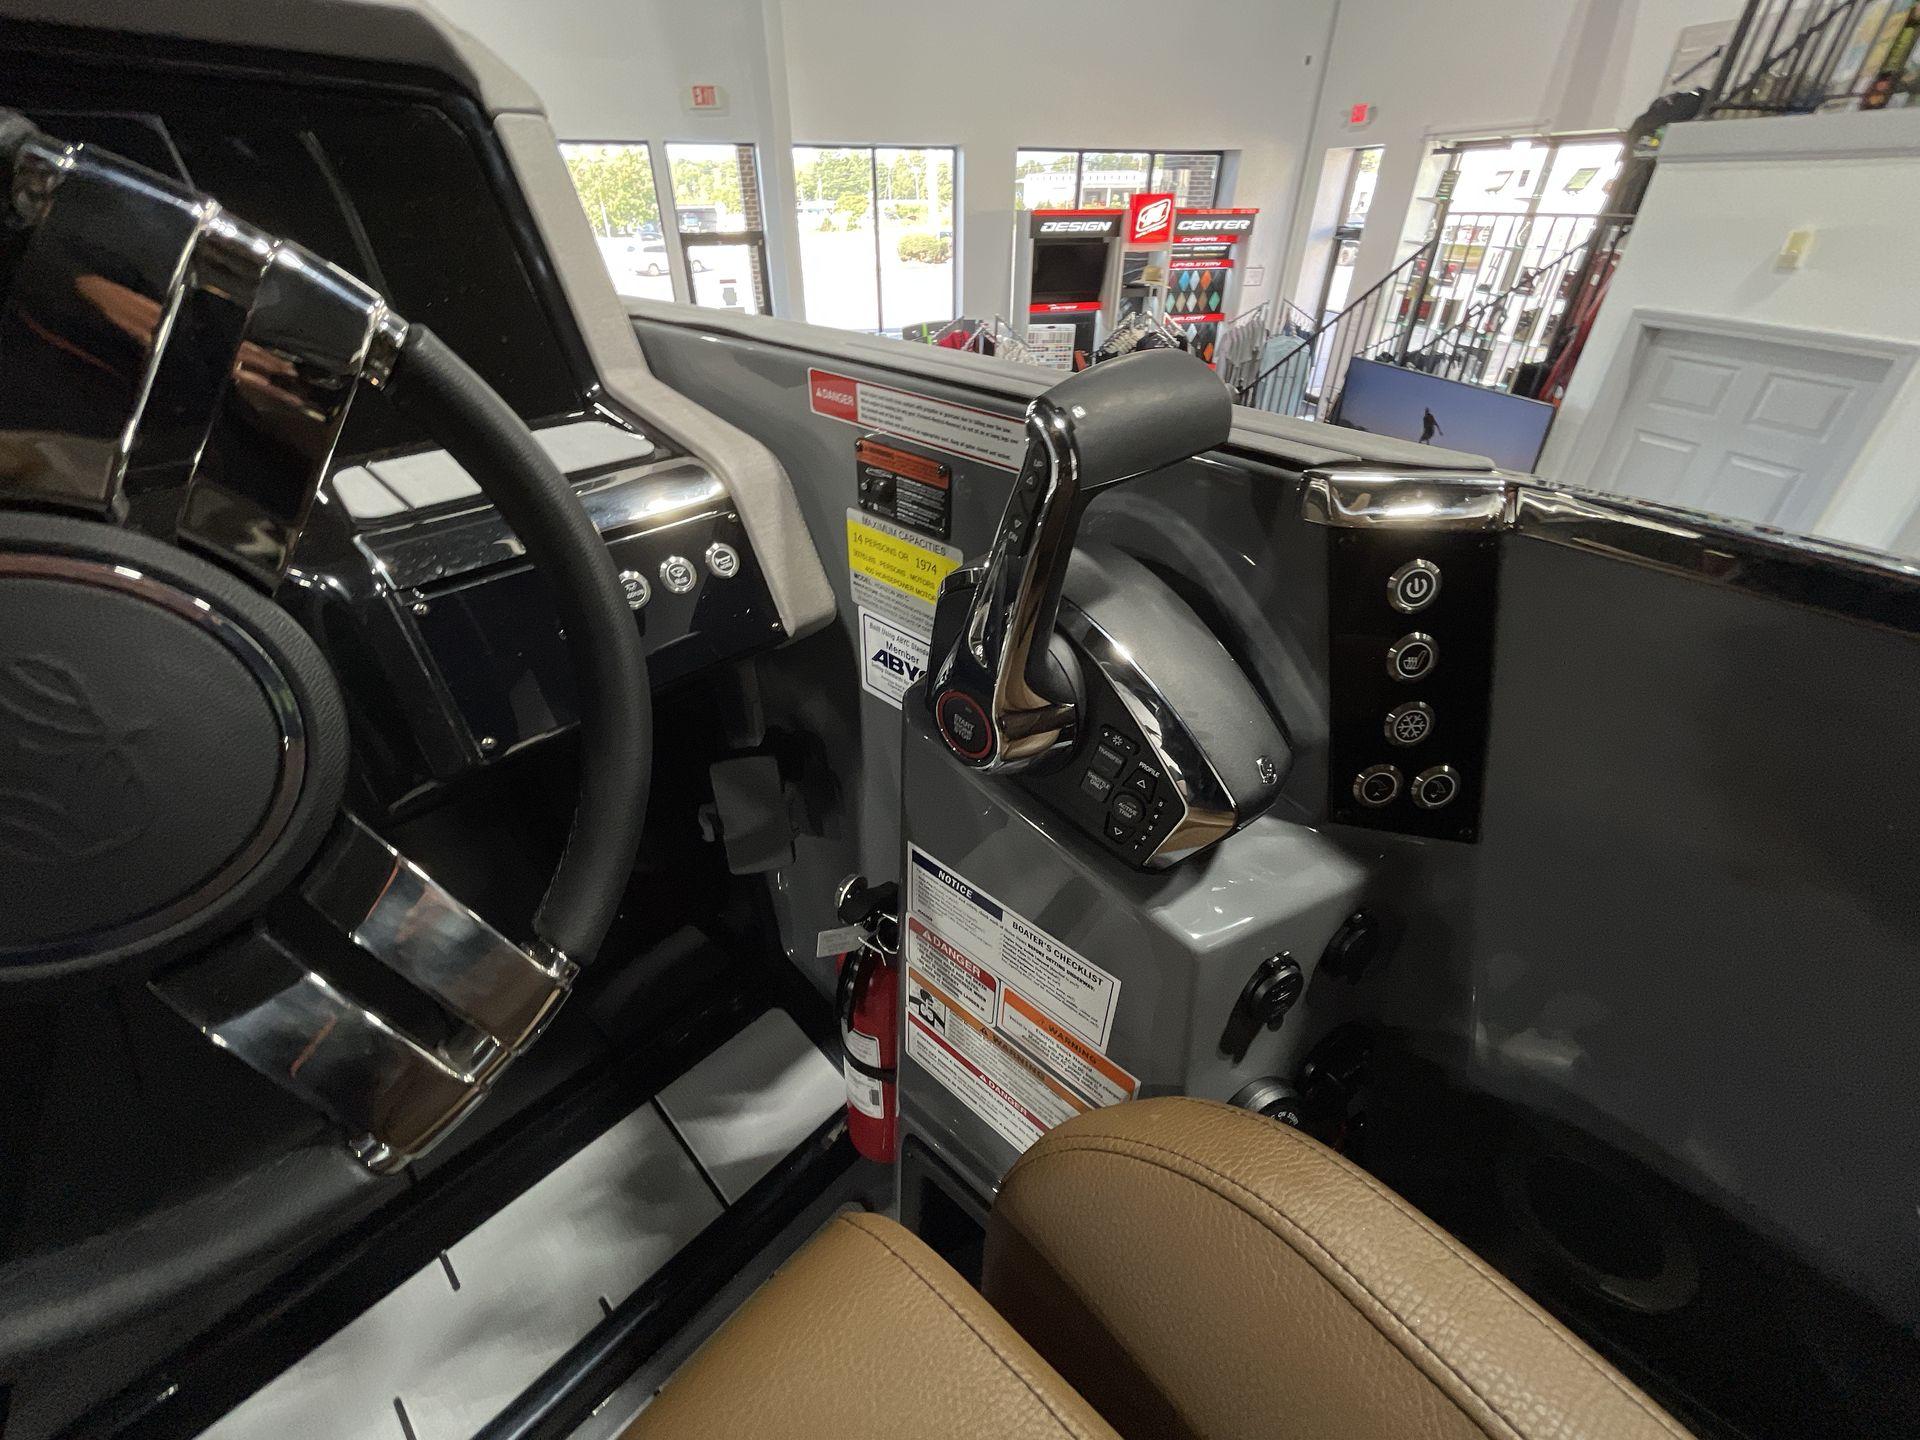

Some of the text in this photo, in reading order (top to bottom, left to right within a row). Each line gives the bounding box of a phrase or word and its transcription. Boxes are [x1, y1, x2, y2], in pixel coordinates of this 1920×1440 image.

[1040, 221, 1113, 232] DESIGN
[1177, 219, 1251, 231] CENTER
[823, 389, 855, 407] DANGER
[862, 515, 897, 536] MAXIMUM
[898, 529, 946, 557] CAPACITIES
[852, 531, 862, 544] 14
[864, 536, 896, 556] PERSONS
[914, 557, 937, 575] 1974
[885, 640, 920, 664] Member
[1138, 761, 1161, 778] PROFILE
[1090, 779, 1103, 790] ONLY
[1118, 802, 1137, 816] ACTIVE
[1119, 808, 1132, 819] TRIM
[937, 868, 973, 900] NOTICE
[933, 935, 980, 978] DANGER
[1011, 920, 1051, 953] BOATER'S
[1053, 948, 1103, 987] CHECKLIST
[1027, 943, 1044, 957] BEFORE
[1045, 955, 1065, 972] GETTING
[992, 1036, 1046, 1081] WARNING
[1047, 1024, 1097, 1064] WARNING
[987, 1081, 1028, 1116] DANGER
